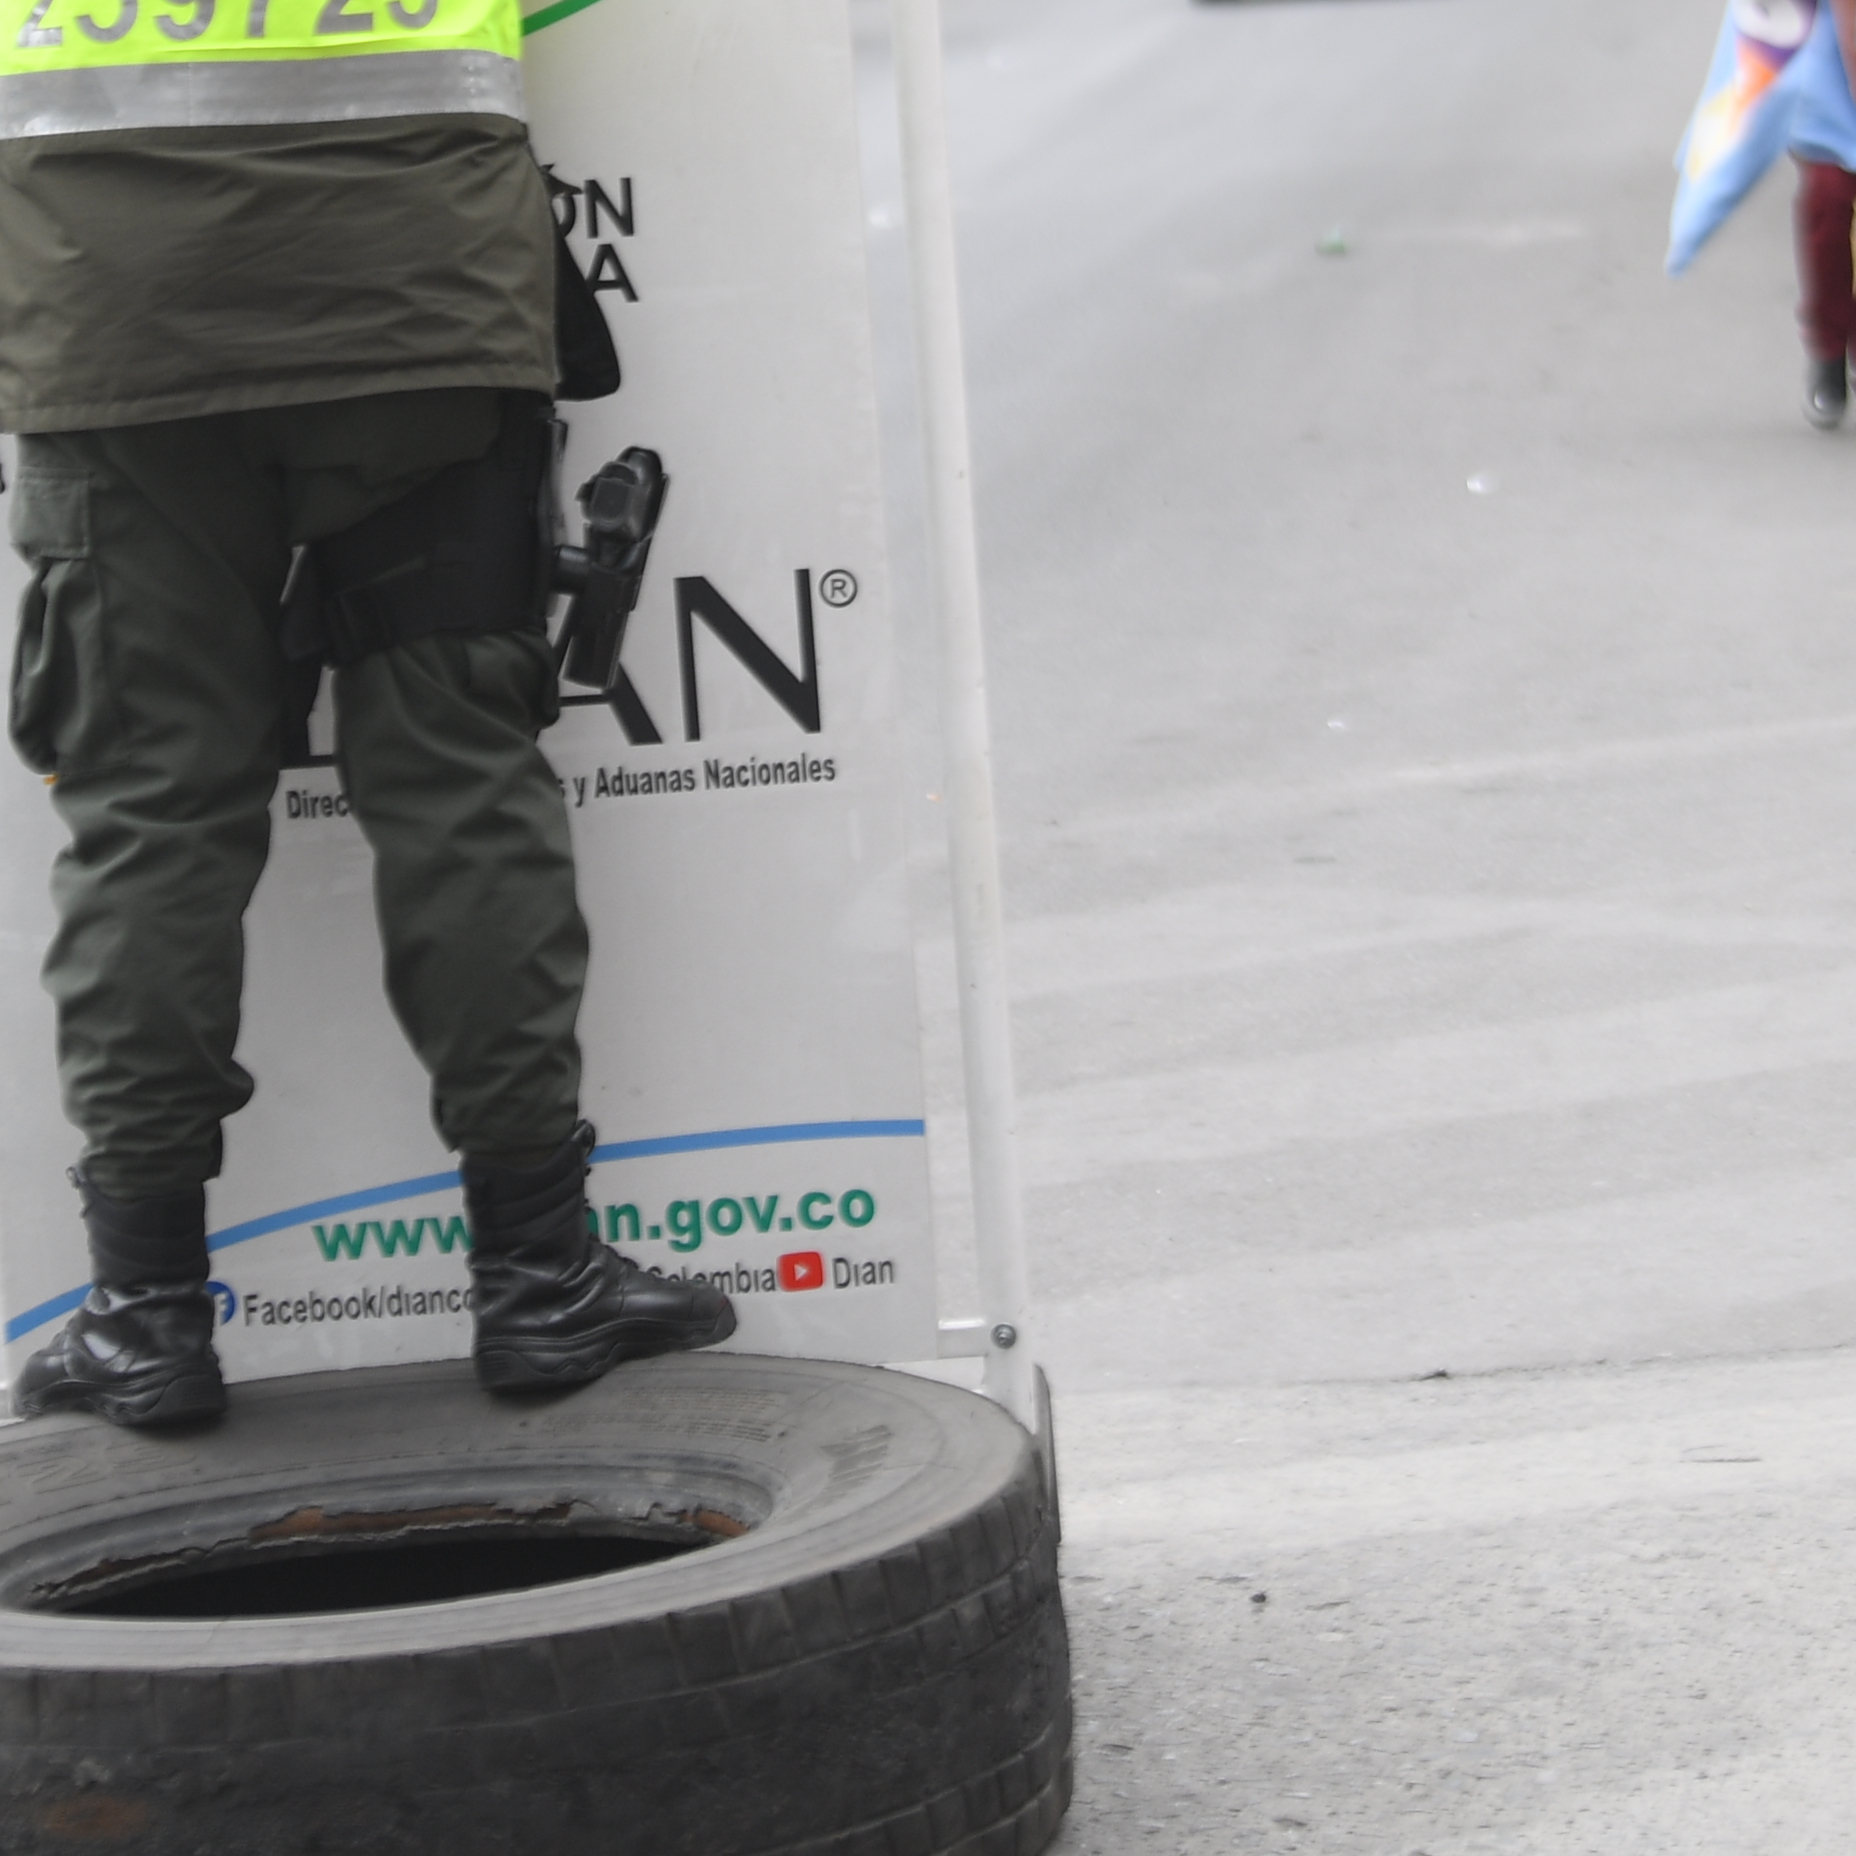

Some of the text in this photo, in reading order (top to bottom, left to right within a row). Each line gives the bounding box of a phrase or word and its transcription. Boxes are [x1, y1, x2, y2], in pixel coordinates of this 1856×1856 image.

[286, 790, 348, 820] Direc
[573, 774, 586, 808] y
[595, 766, 696, 800] Aduanas
[704, 753, 836, 792] Nacionales
